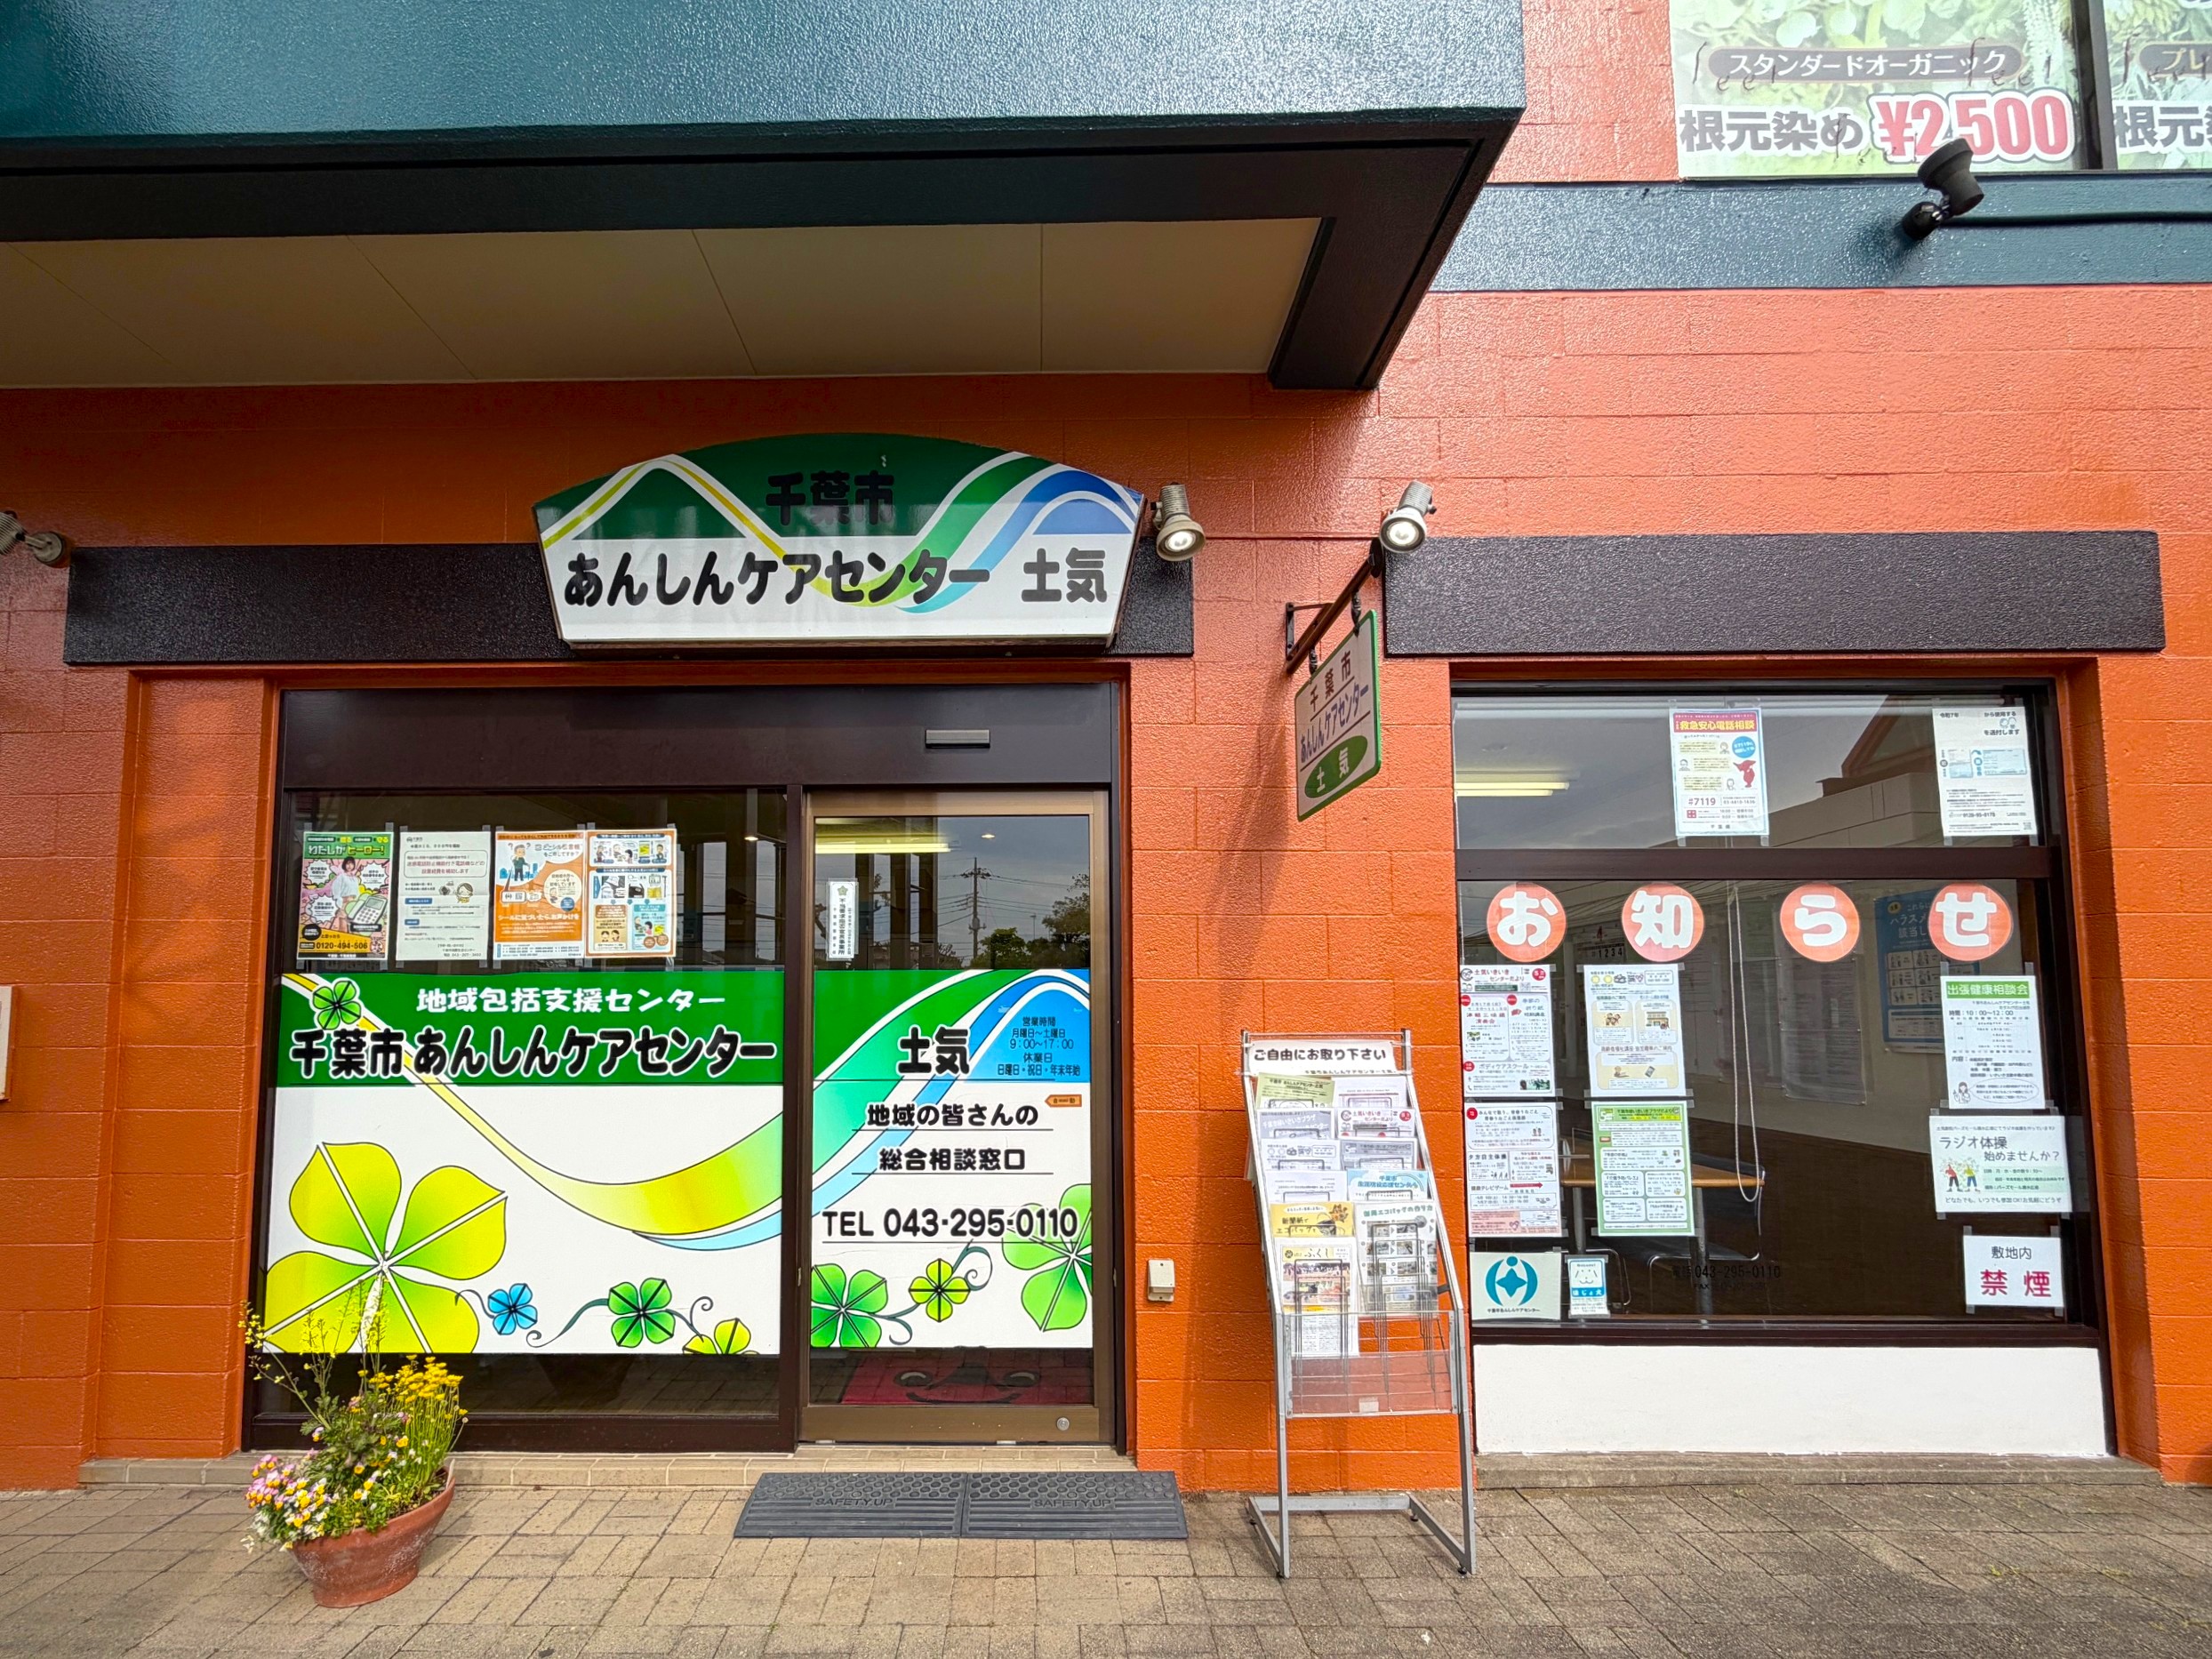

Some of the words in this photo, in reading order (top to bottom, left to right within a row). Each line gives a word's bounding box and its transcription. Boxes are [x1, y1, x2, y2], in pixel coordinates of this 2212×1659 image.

[1730, 50, 2007, 76] スタンダードオーガニック
[1679, 109, 1863, 152] 根元染め
[1876, 95, 2068, 156] ¥2500
[2113, 105, 2212, 148] 根元
[765, 469, 895, 526] 千葉市
[564, 549, 990, 606] あんしんケアセンター
[1022, 547, 1108, 604] 土気
[1310, 650, 1351, 713] 千葉市
[1300, 682, 1369, 764] あんしんケアセンター
[1679, 719, 1755, 731] 救急安心電話相談
[1316, 746, 1350, 793] 土気
[416, 987, 725, 1014] 地域包括支援センター
[1947, 983, 2028, 996] 出張健康相談会
[1022, 1016, 1056, 1027] 営業時間
[293, 1028, 405, 1078] 千葉市
[414, 1025, 777, 1078] あんしんケアセンター
[898, 1026, 970, 1076] 土気
[1023, 1052, 1053, 1063] 休業日
[1254, 1047, 1387, 1062] ご自由にお取り下さい
[998, 1063, 1081, 1077] 日曜日・祝日・年末年始
[867, 1103, 1038, 1126] 地域の皆さんの
[1938, 1135, 2008, 1150] ラジオ体操
[879, 1148, 1026, 1171] 総合相談窓口
[1984, 1150, 2060, 1162] 始めませんか？
[821, 1211, 874, 1237] TEL
[1991, 1246, 2032, 1260] 敷地内
[1695, 1265, 1781, 1278] 043-295-0110
[1980, 1269, 2052, 1298] 禁煙
